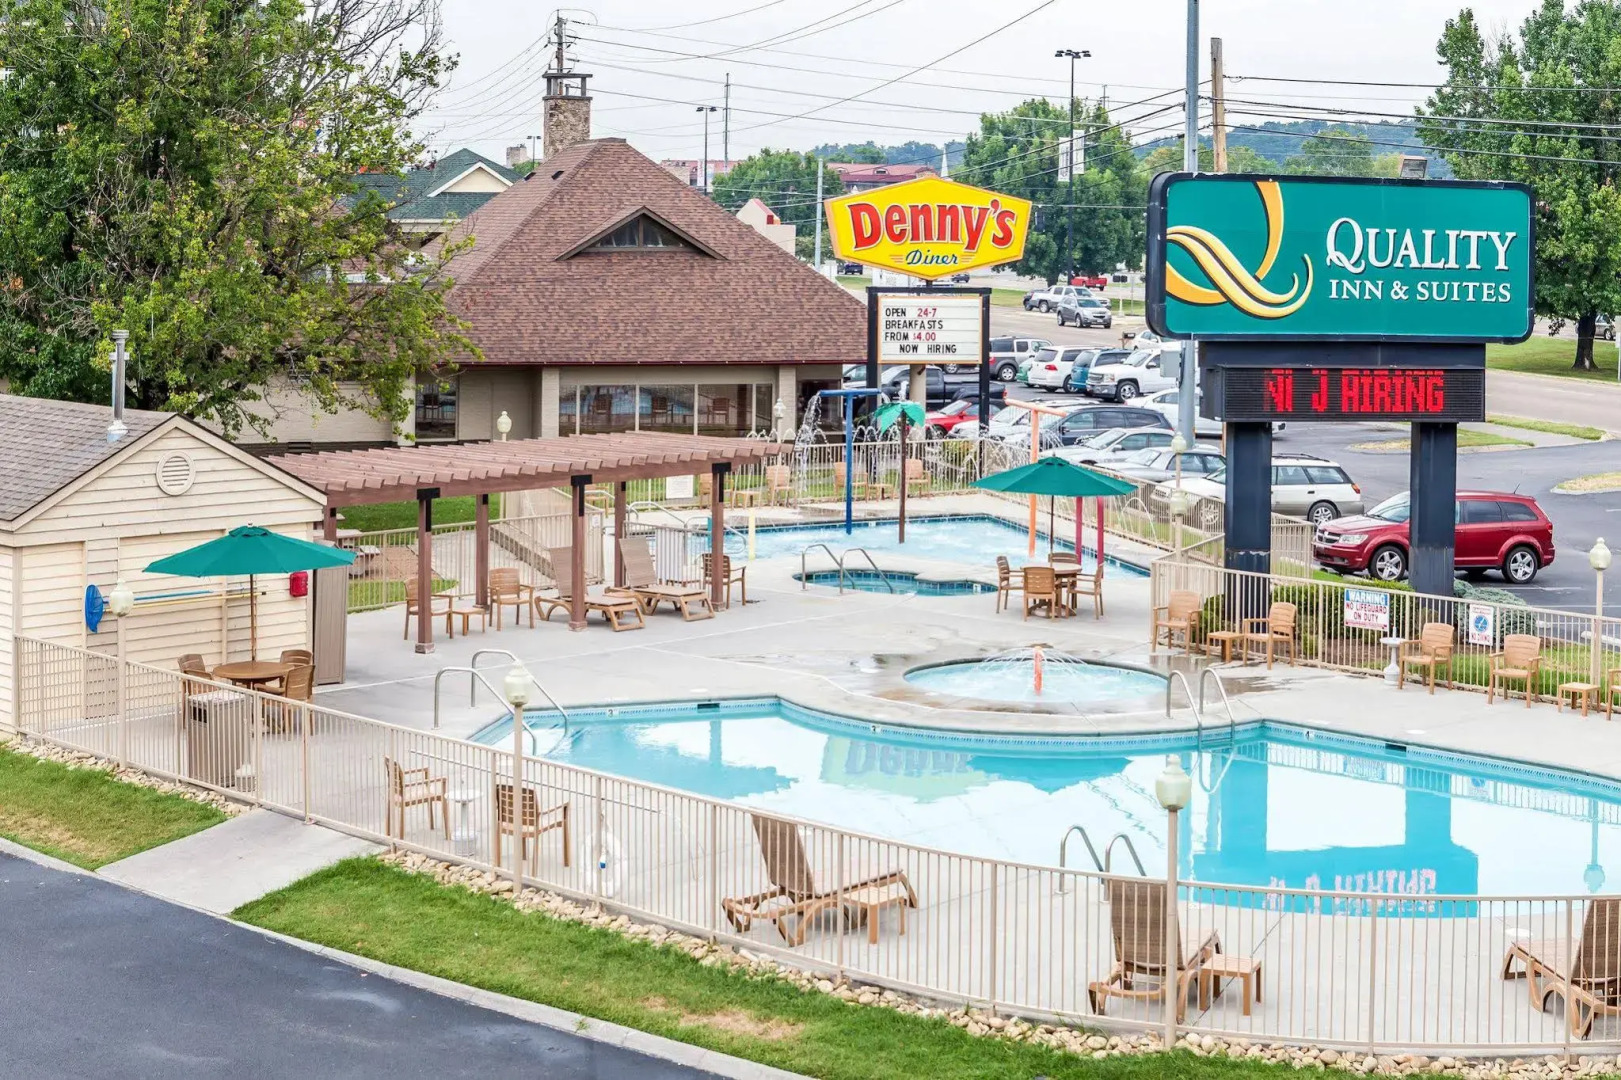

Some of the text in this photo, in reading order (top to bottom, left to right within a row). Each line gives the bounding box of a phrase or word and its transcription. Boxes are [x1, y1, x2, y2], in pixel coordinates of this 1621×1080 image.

[847, 199, 1017, 252] Denny's
[1326, 217, 1517, 274] QUALITY
[905, 249, 959, 265] Diner
[1329, 279, 1512, 302] INN & SUITES
[885, 307, 938, 318] OPEN 24-7
[885, 320, 944, 330] BREAKFASTS
[884, 332, 910, 341] FROM
[900, 344, 957, 354] NOW HIRING
[1341, 369, 1445, 412] HIRING
[1349, 590, 1387, 606] WARNING
[1346, 602, 1388, 615] NO LIFEGUARD
[1353, 611, 1379, 622] ON DUTY
